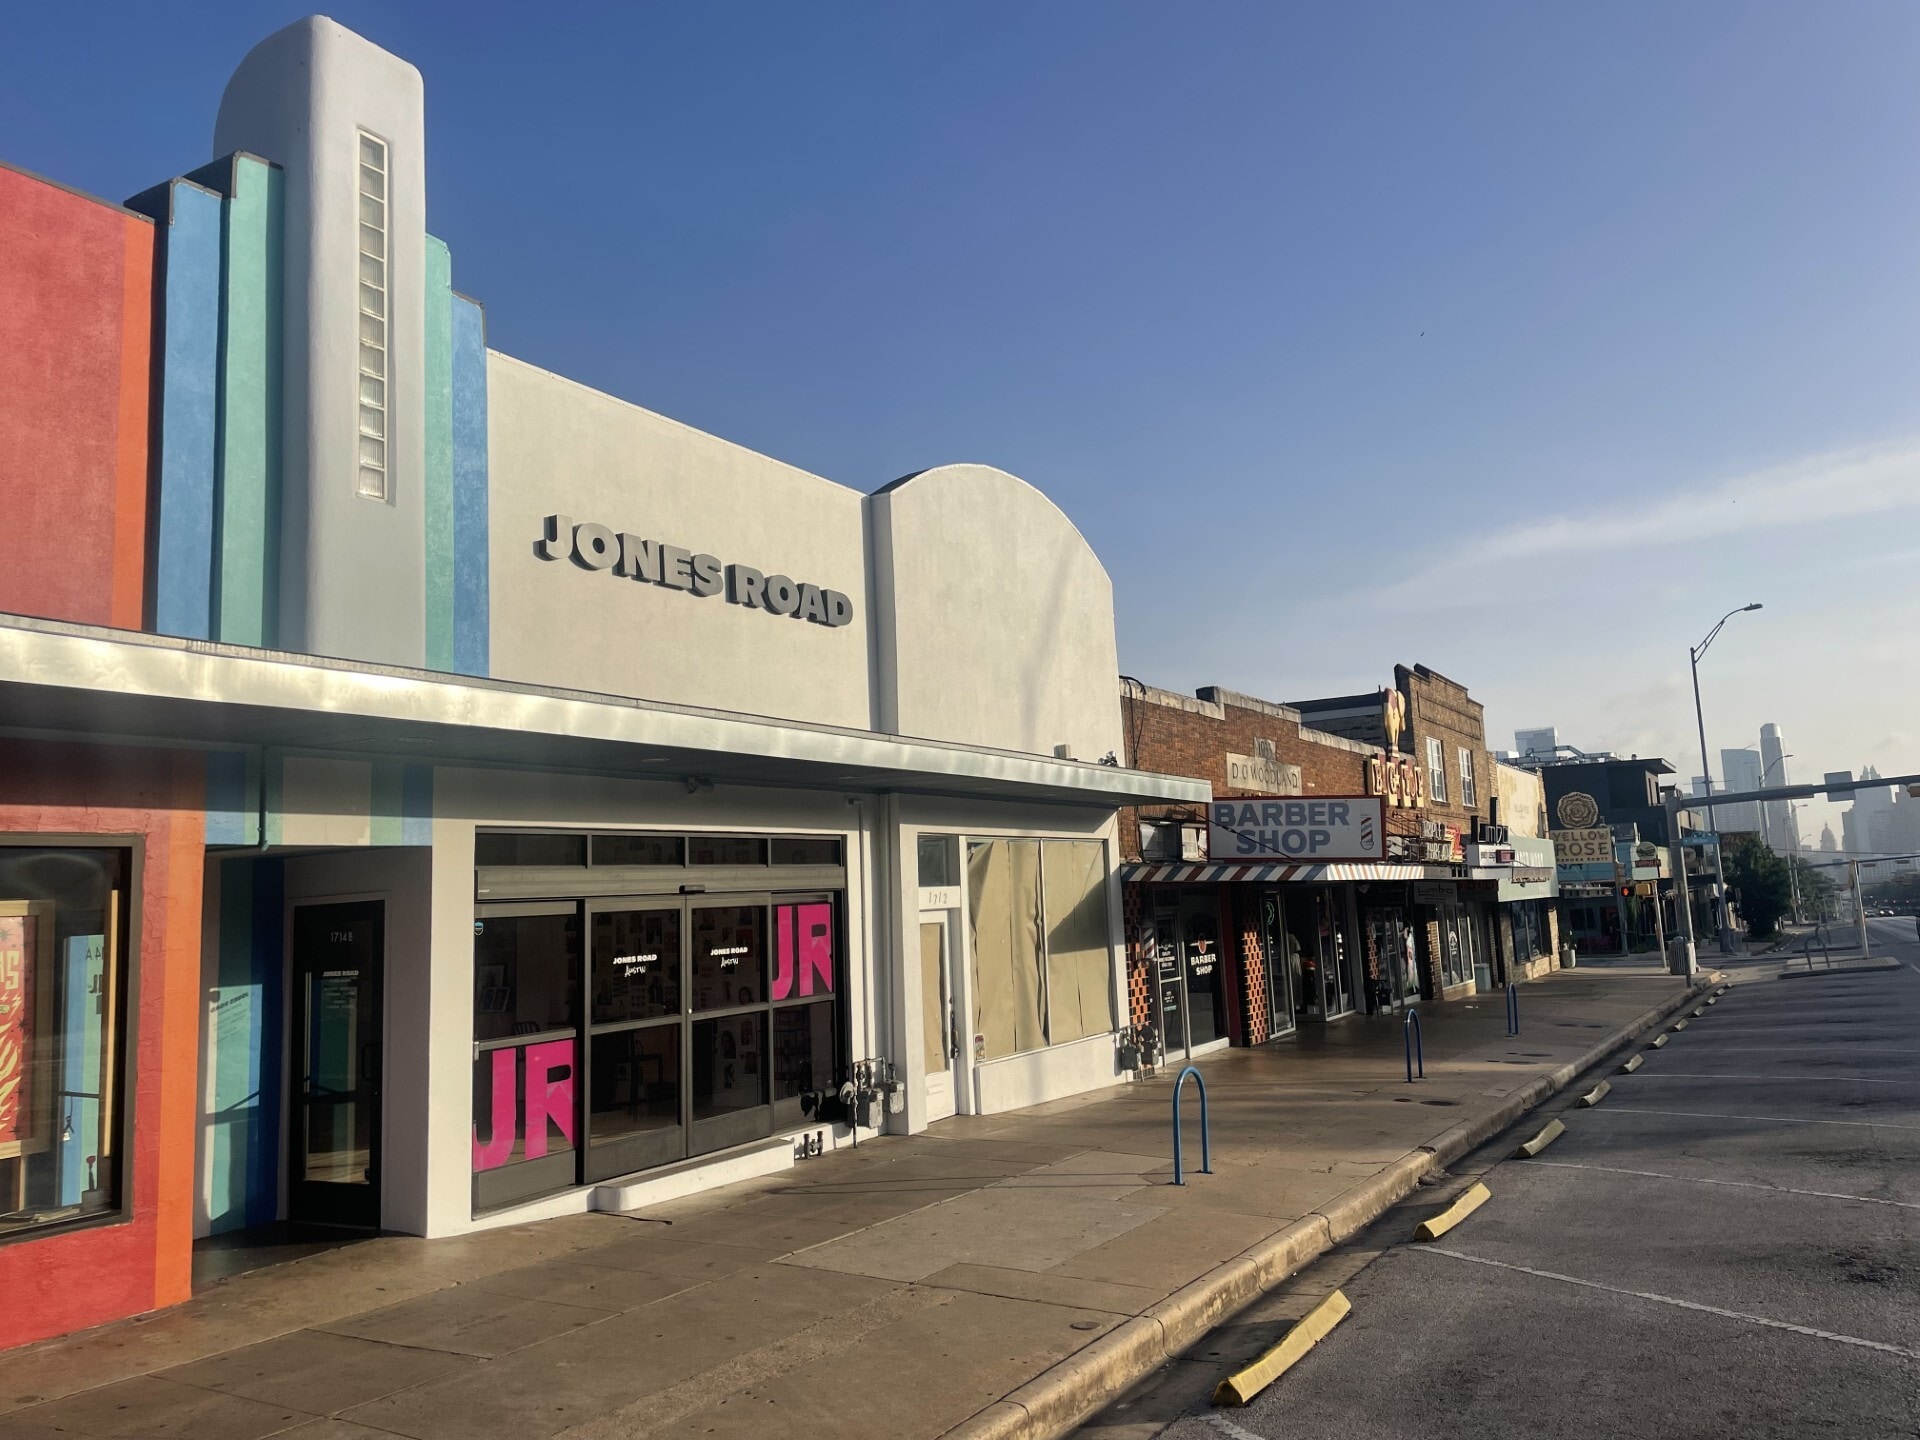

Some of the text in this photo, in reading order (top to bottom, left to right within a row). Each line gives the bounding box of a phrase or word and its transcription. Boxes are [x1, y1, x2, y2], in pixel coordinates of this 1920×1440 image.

[533, 514, 854, 627] JONES ROAD
[1250, 765, 1298, 789] WOODLAND
[1213, 802, 1350, 827] BARBER
[1236, 829, 1331, 854] SHOP
[1552, 830, 1609, 841] YELLOW
[1555, 842, 1609, 857] ROSE
[928, 891, 948, 906] 1712
[709, 946, 748, 956] JONES ROAD
[772, 903, 833, 1001] JR
[613, 953, 657, 965] JONES ROAD
[1190, 953, 1217, 966] BARBER
[1195, 965, 1213, 976] SHOP
[473, 1040, 575, 1172] JR
